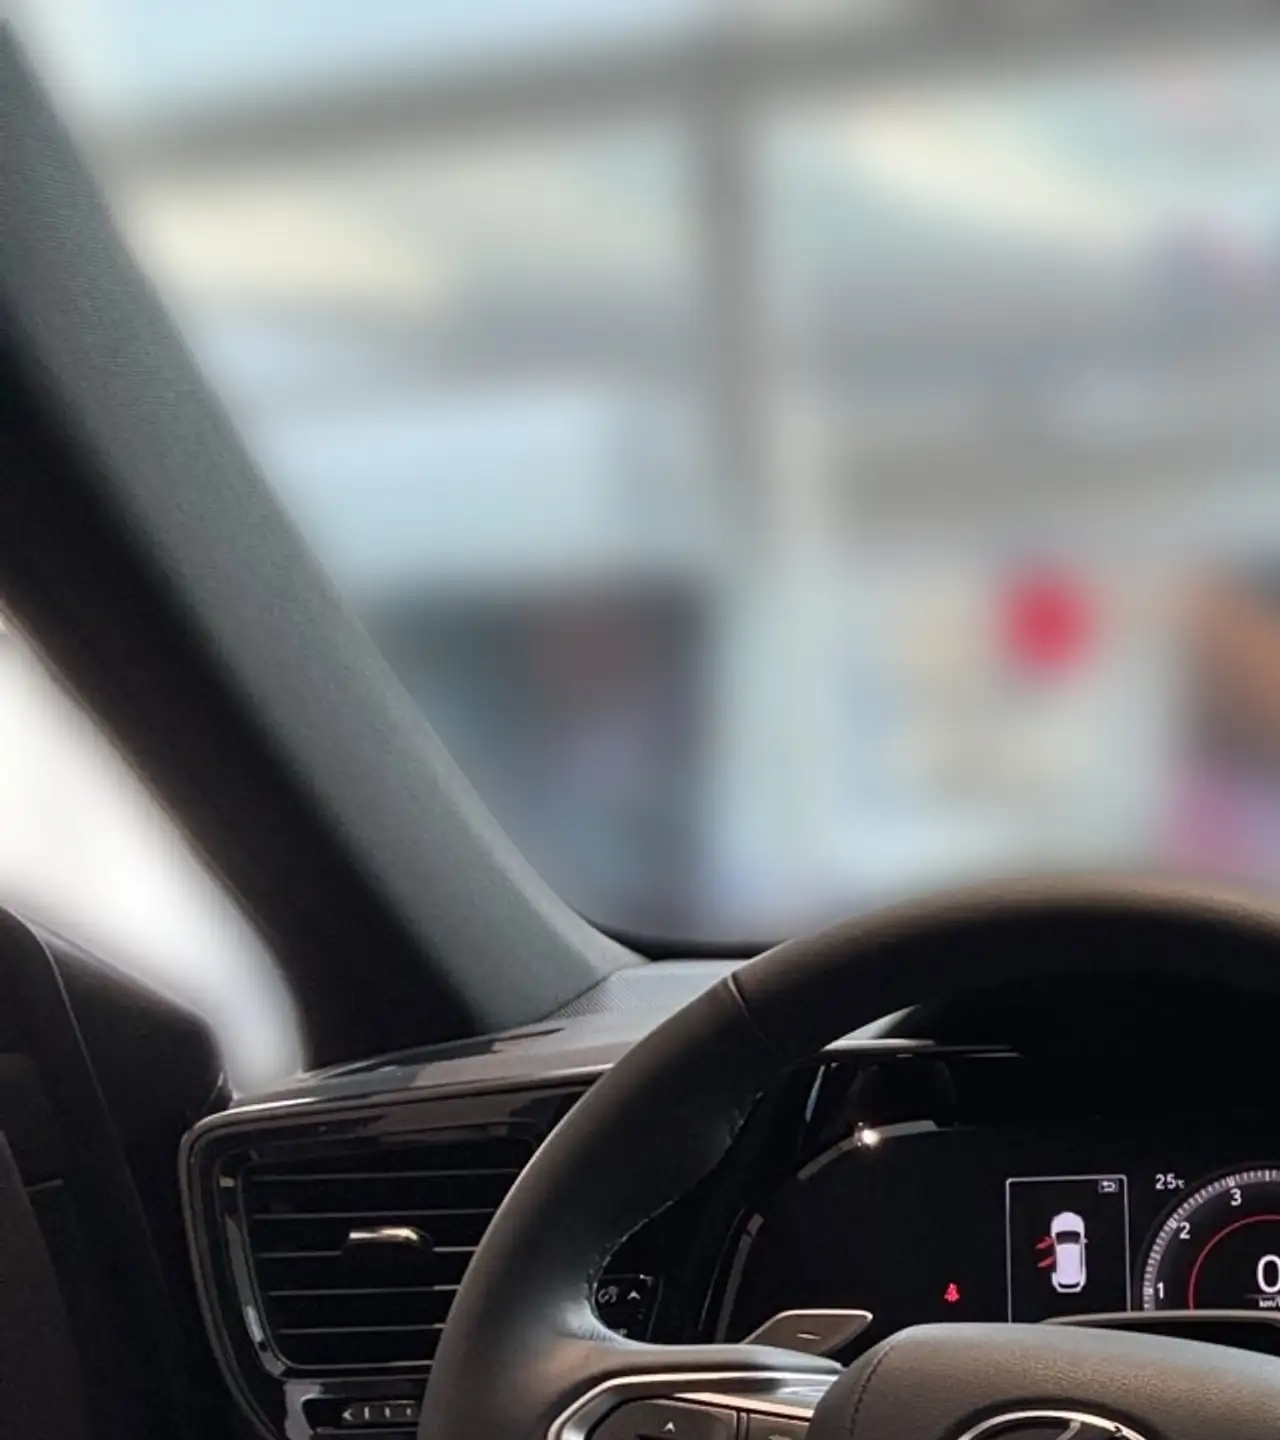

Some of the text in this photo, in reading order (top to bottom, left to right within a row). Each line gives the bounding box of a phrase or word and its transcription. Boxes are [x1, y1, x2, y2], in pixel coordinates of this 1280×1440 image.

[1229, 1188, 1243, 1207] 3
[1178, 1221, 1191, 1240] 2
[1155, 1281, 1165, 1300] 1
